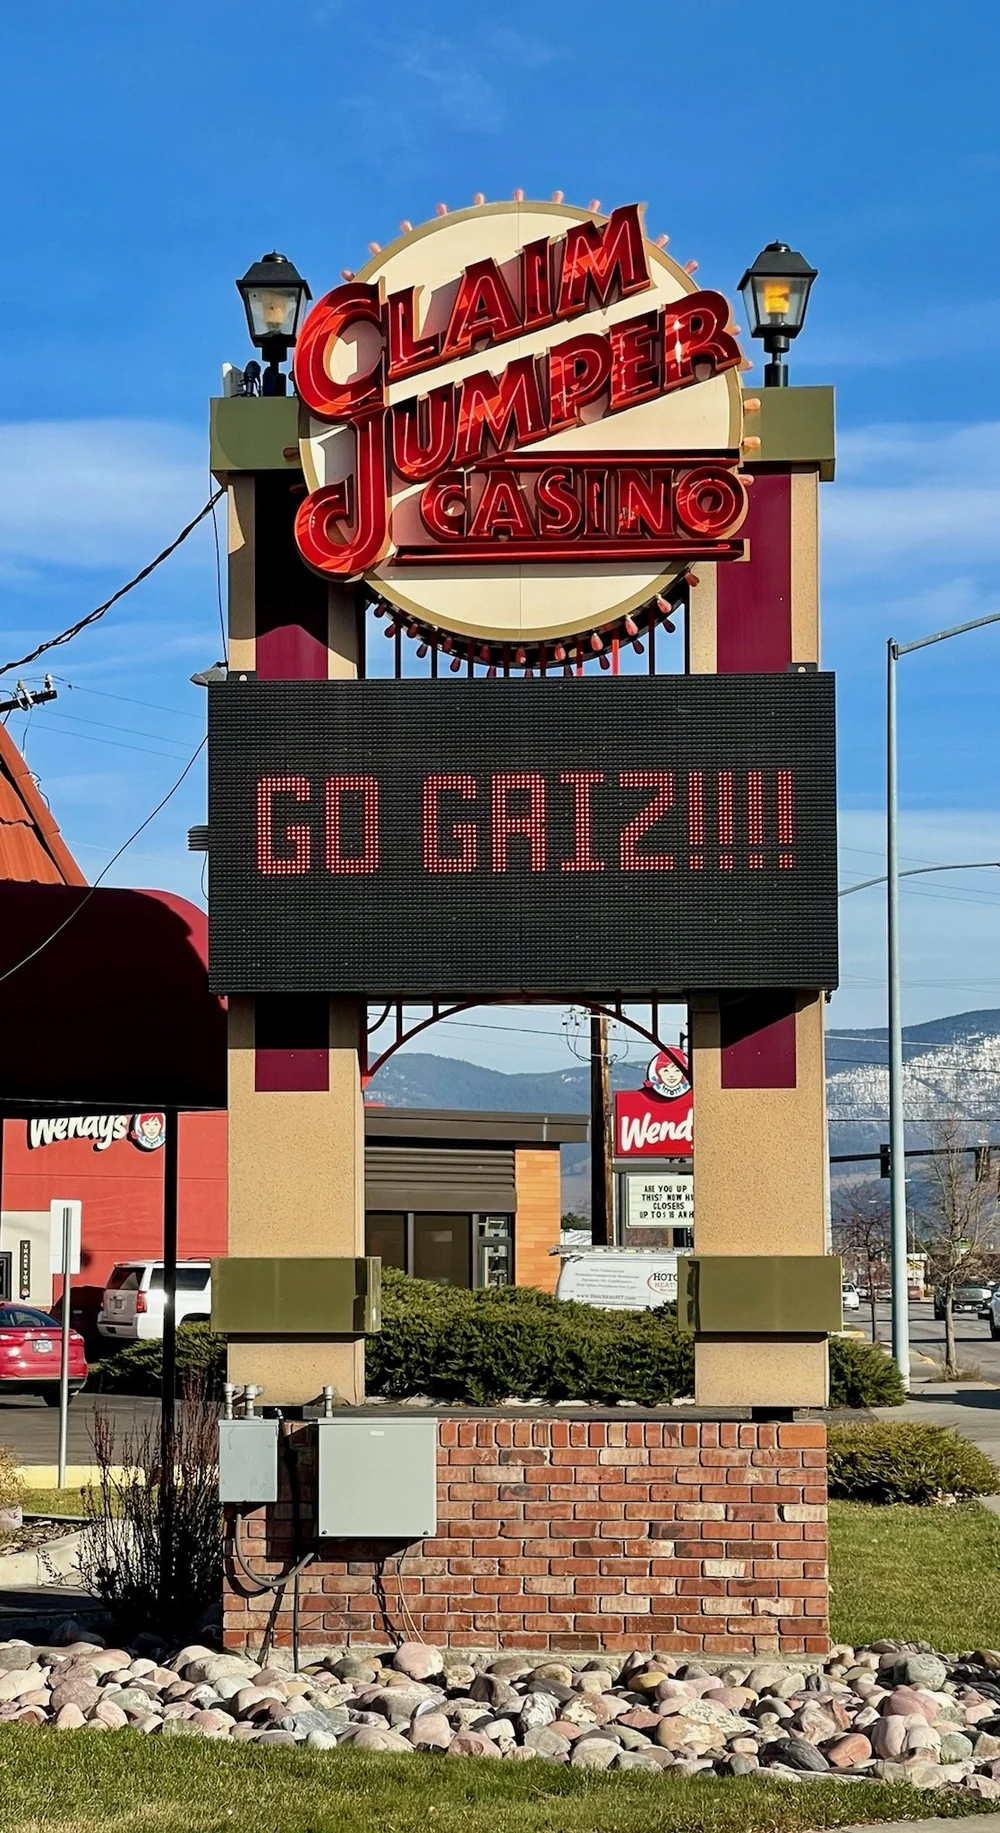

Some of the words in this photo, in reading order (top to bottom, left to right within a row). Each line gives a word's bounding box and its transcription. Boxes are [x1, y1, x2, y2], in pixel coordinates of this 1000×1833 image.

[294, 203, 650, 422] CLAIM
[294, 289, 742, 582] JUMPER
[420, 466, 747, 541] CASINO
[256, 775, 380, 875] GO
[621, 1108, 694, 1152] Wend
[653, 1202, 685, 1210] CLOSERS
